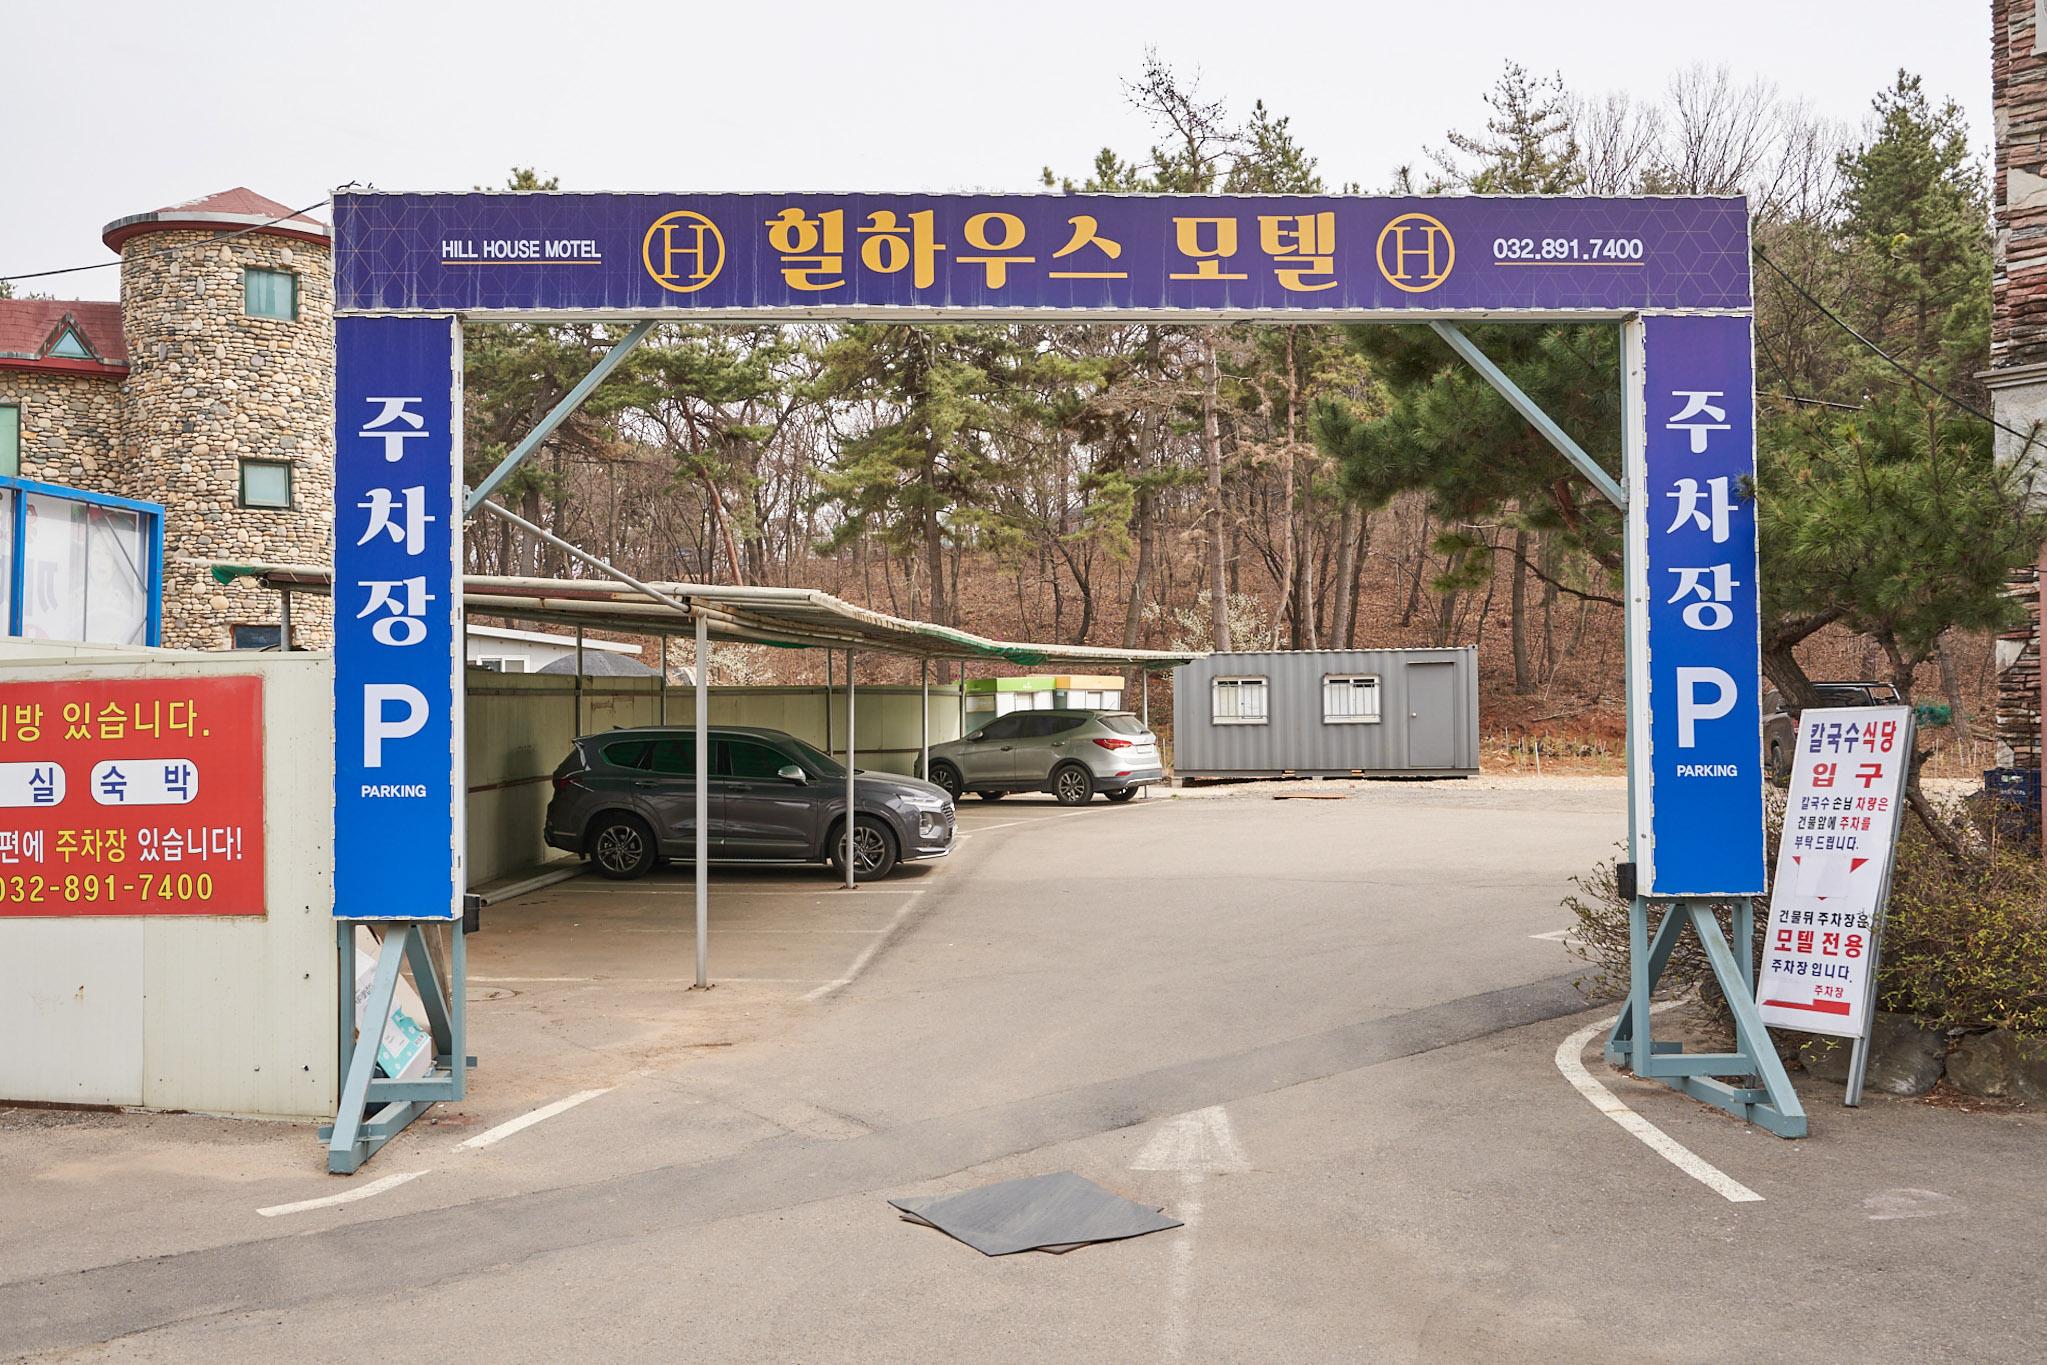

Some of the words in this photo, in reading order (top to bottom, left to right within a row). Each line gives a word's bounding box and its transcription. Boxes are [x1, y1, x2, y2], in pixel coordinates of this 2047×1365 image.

[442, 240, 479, 258] HILL
[483, 239, 541, 259] HOUSE
[545, 239, 602, 258] MOTEL
[656, 224, 711, 279] H
[765, 207, 1128, 291] 힐하우스
[1169, 211, 1338, 291] 모텔
[1389, 226, 1442, 279] H
[1493, 238, 1644, 260] 032.891.7400
[356, 396, 436, 647] 주차장
[1665, 390, 1740, 631] 주차장
[62, 699, 210, 740] 있습니다.
[1676, 666, 1738, 748] P
[363, 683, 430, 768] P
[28, 767, 55, 803] 실
[1676, 764, 1738, 778] PARKING
[361, 784, 427, 798] PARKING
[1801, 796, 1830, 811] 칼국수
[1832, 796, 1853, 811] 손님
[1855, 797, 1889, 812] 차량은
[1839, 816, 1871, 831] 주차를
[55, 828, 128, 864] 주차장
[137, 826, 242, 862] 있습니다!
[1779, 909, 1814, 925] 건물뒤
[1774, 929, 1815, 954] 모텔
[1822, 932, 1864, 958] 전용
[1771, 959, 1808, 975] 주차장
[1814, 984, 1844, 999] 주차장
